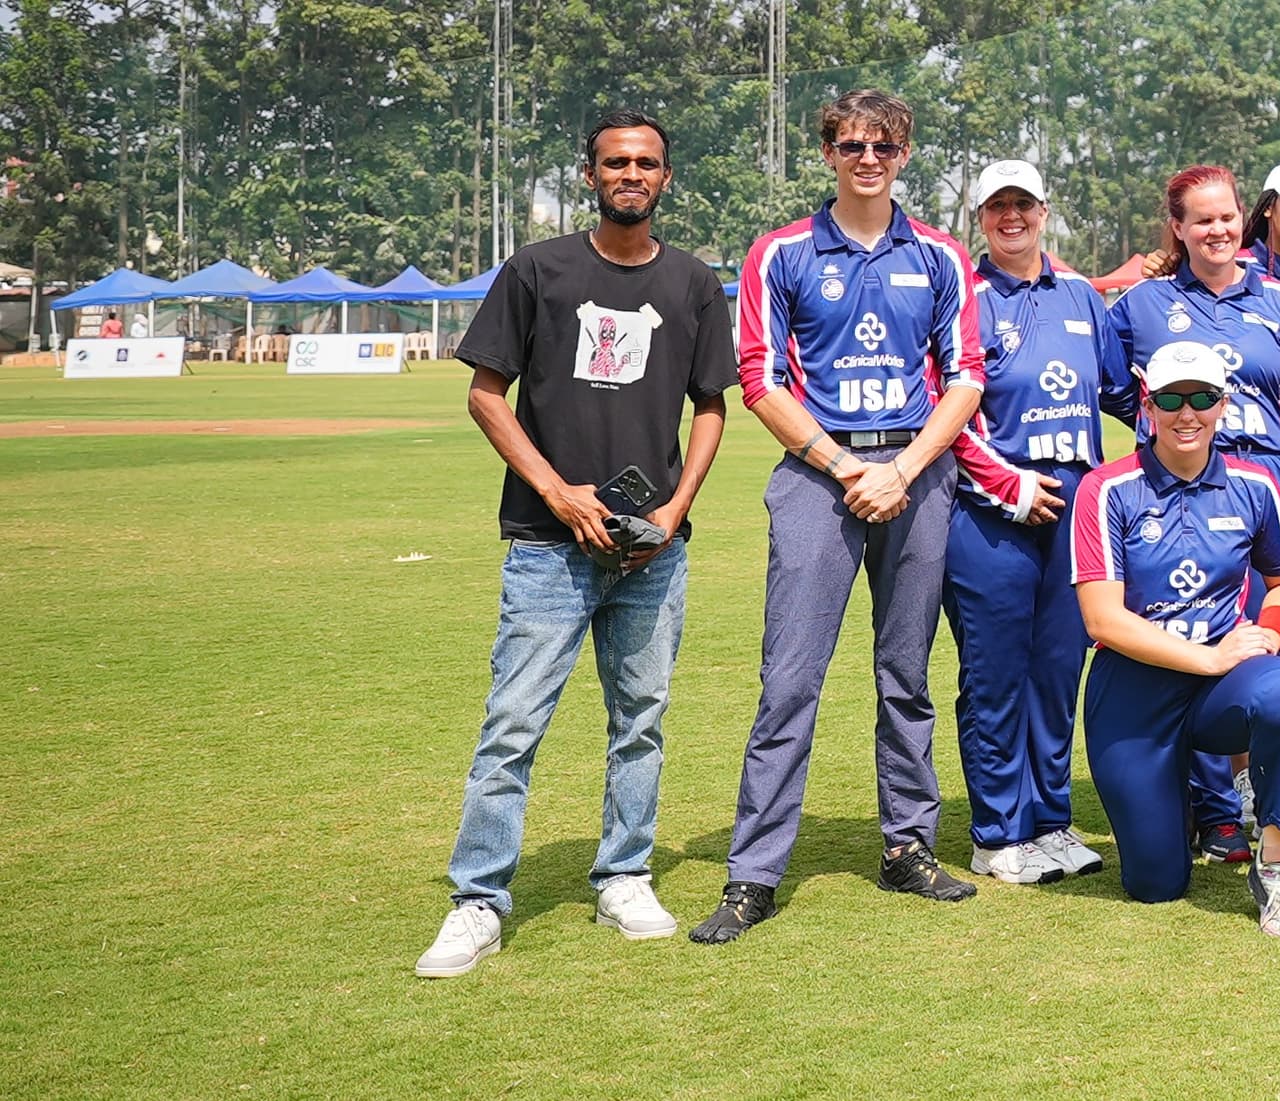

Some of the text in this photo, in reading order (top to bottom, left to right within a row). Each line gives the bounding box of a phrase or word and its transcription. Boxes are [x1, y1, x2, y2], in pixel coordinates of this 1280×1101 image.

[295, 358, 316, 368] CSC
[839, 378, 907, 413] USA
[1215, 403, 1268, 435] SA
[1028, 430, 1092, 464] USA
